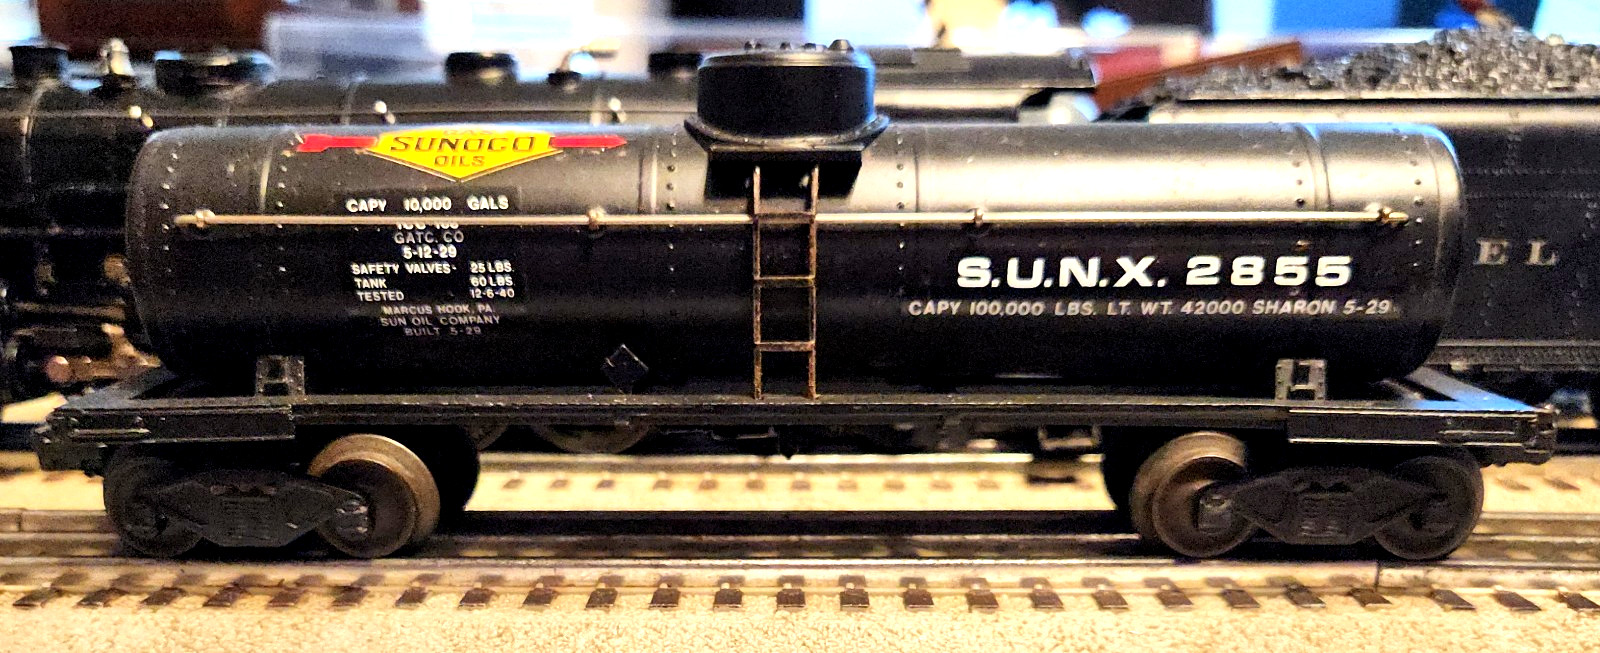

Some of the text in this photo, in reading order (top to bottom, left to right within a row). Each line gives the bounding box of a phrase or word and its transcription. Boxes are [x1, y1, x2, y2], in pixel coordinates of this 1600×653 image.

[390, 136, 535, 151] SUNOCO
[434, 155, 485, 168] OILS
[346, 194, 509, 213] CAPY 10,000 GALS
[443, 230, 464, 243] CO
[402, 244, 457, 259] 5-12-29
[351, 263, 400, 275] SAFETY
[469, 261, 486, 273] 25
[488, 260, 515, 272] LBS.
[957, 255, 1353, 289] S.U.N.X. 2855
[354, 278, 388, 289] TANK
[470, 276, 487, 287] 60
[357, 288, 515, 302] TESTED 12-6-40
[382, 305, 433, 315] MARCUS
[908, 302, 962, 317] CAPY
[969, 301, 1045, 317] 100,000
[1054, 302, 1098, 317] LBS.
[1107, 302, 1132, 316] LT.
[1180, 301, 1246, 316] 42000
[1251, 300, 1336, 315] SHARON
[1342, 300, 1392, 315] 5-29
[380, 315, 501, 327] SUN OIL COMPANY
[404, 326, 482, 337] BUILT 5-29
